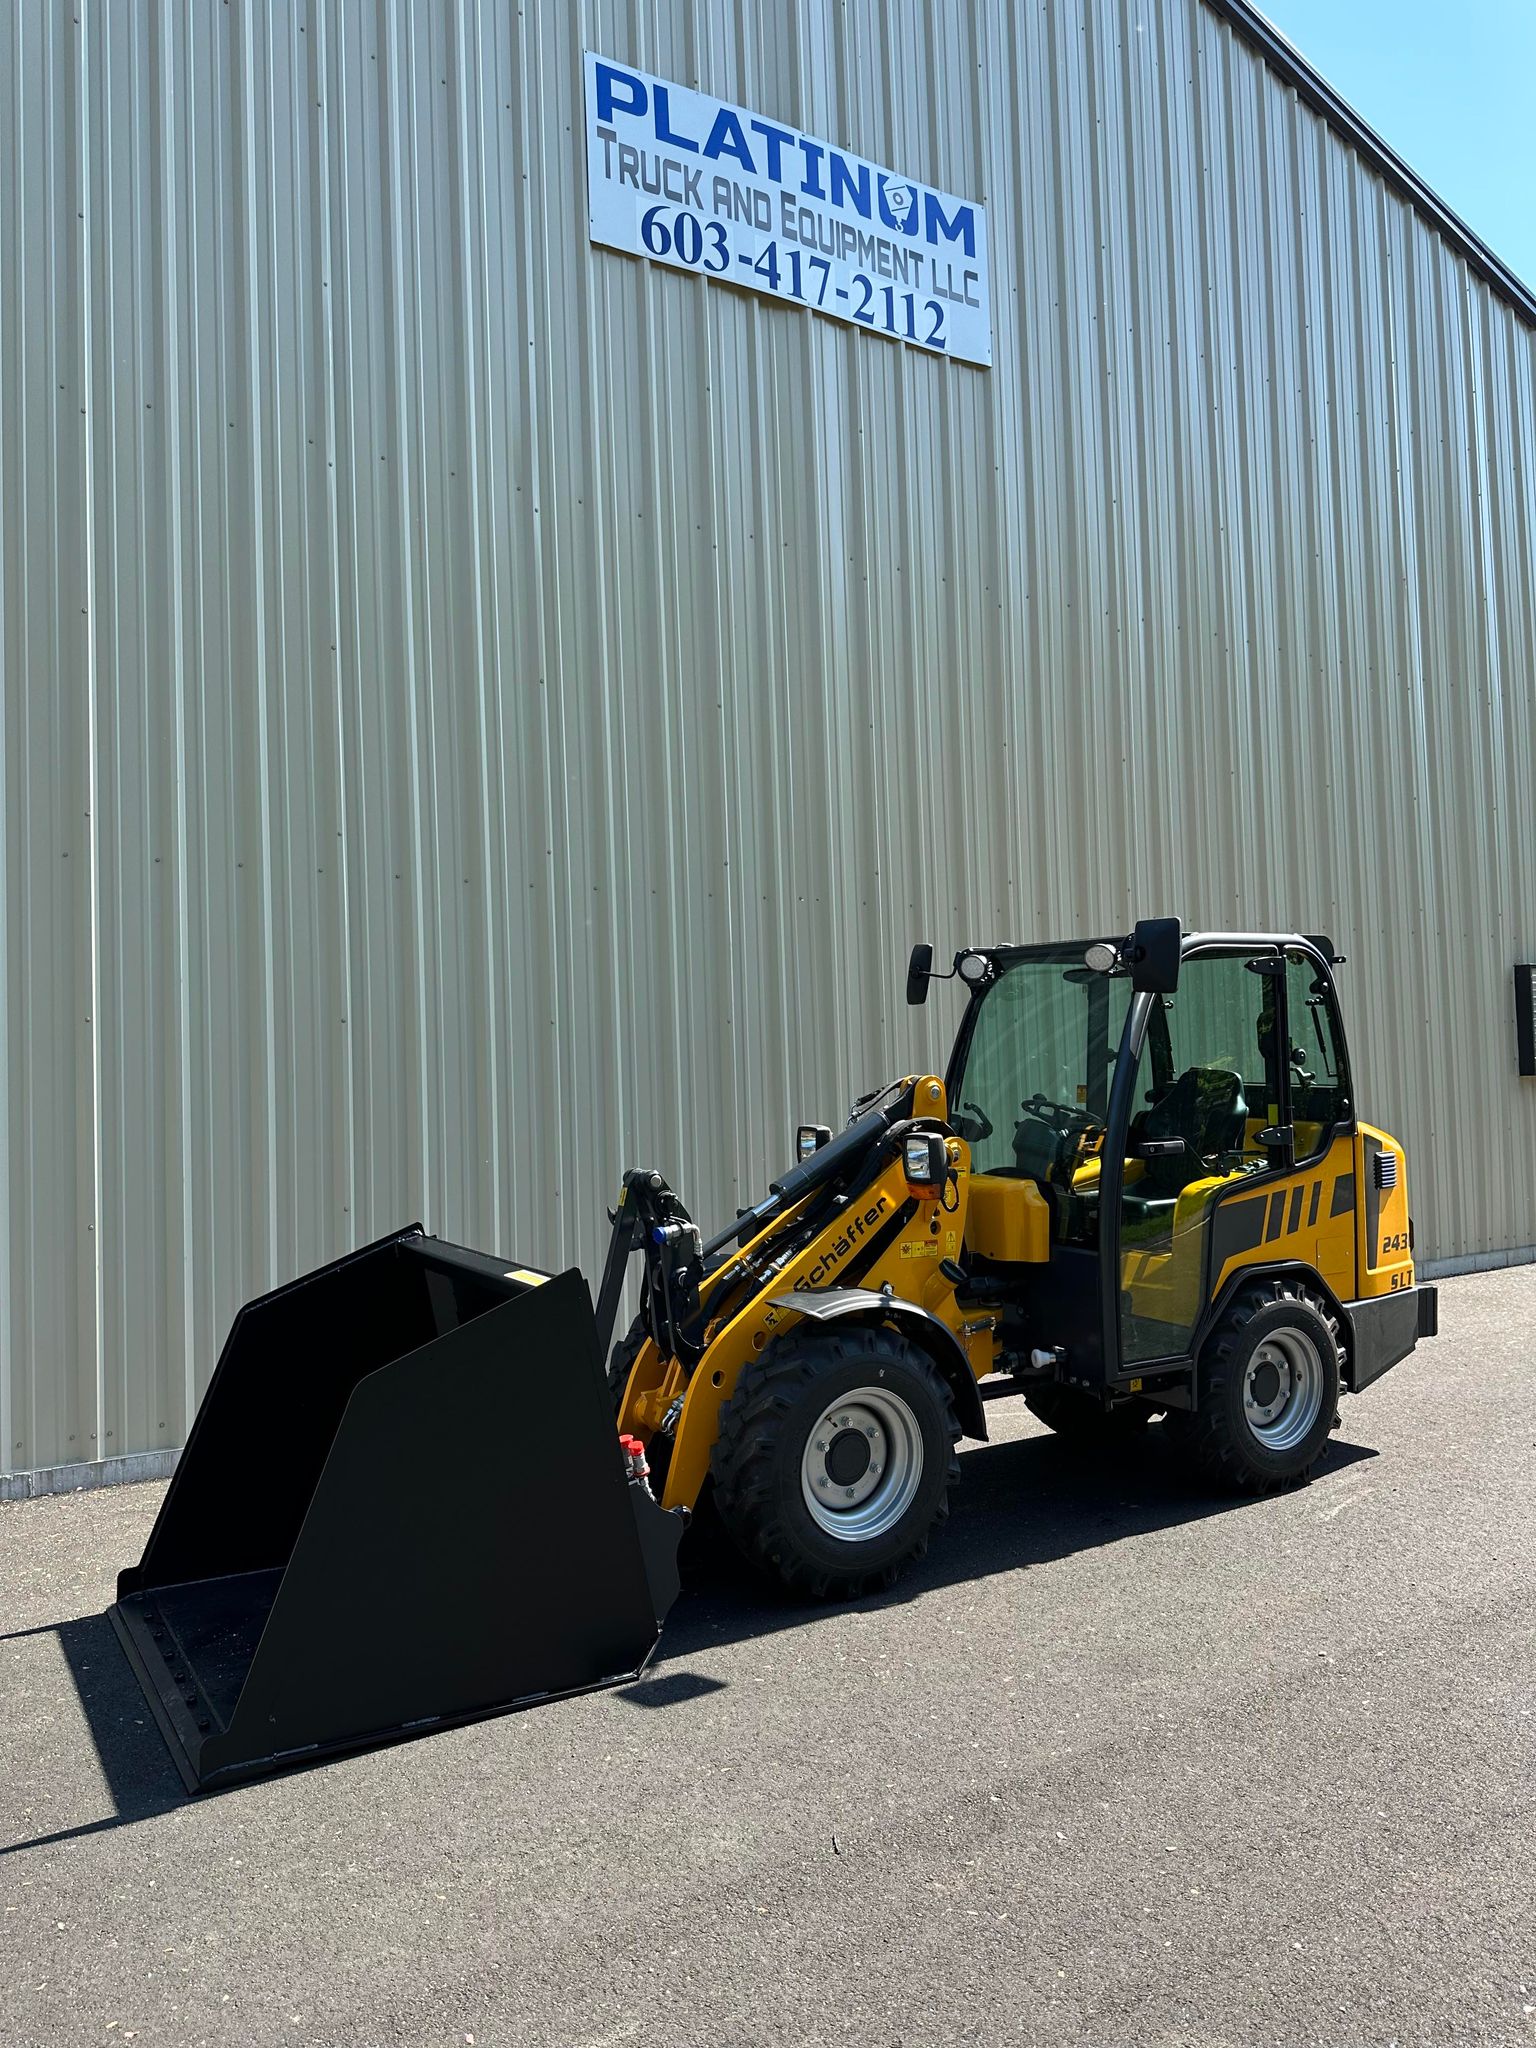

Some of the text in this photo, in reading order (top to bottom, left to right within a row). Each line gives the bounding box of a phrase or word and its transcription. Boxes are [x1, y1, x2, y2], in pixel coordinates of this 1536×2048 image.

[595, 62, 976, 259] PLATINUM
[596, 125, 980, 309] TRUCK AND EQUIPMENT LLC
[641, 205, 947, 350] 603-417-2112
[793, 1197, 887, 1292] Schäffer
[1391, 1270, 1412, 1290] SLT
